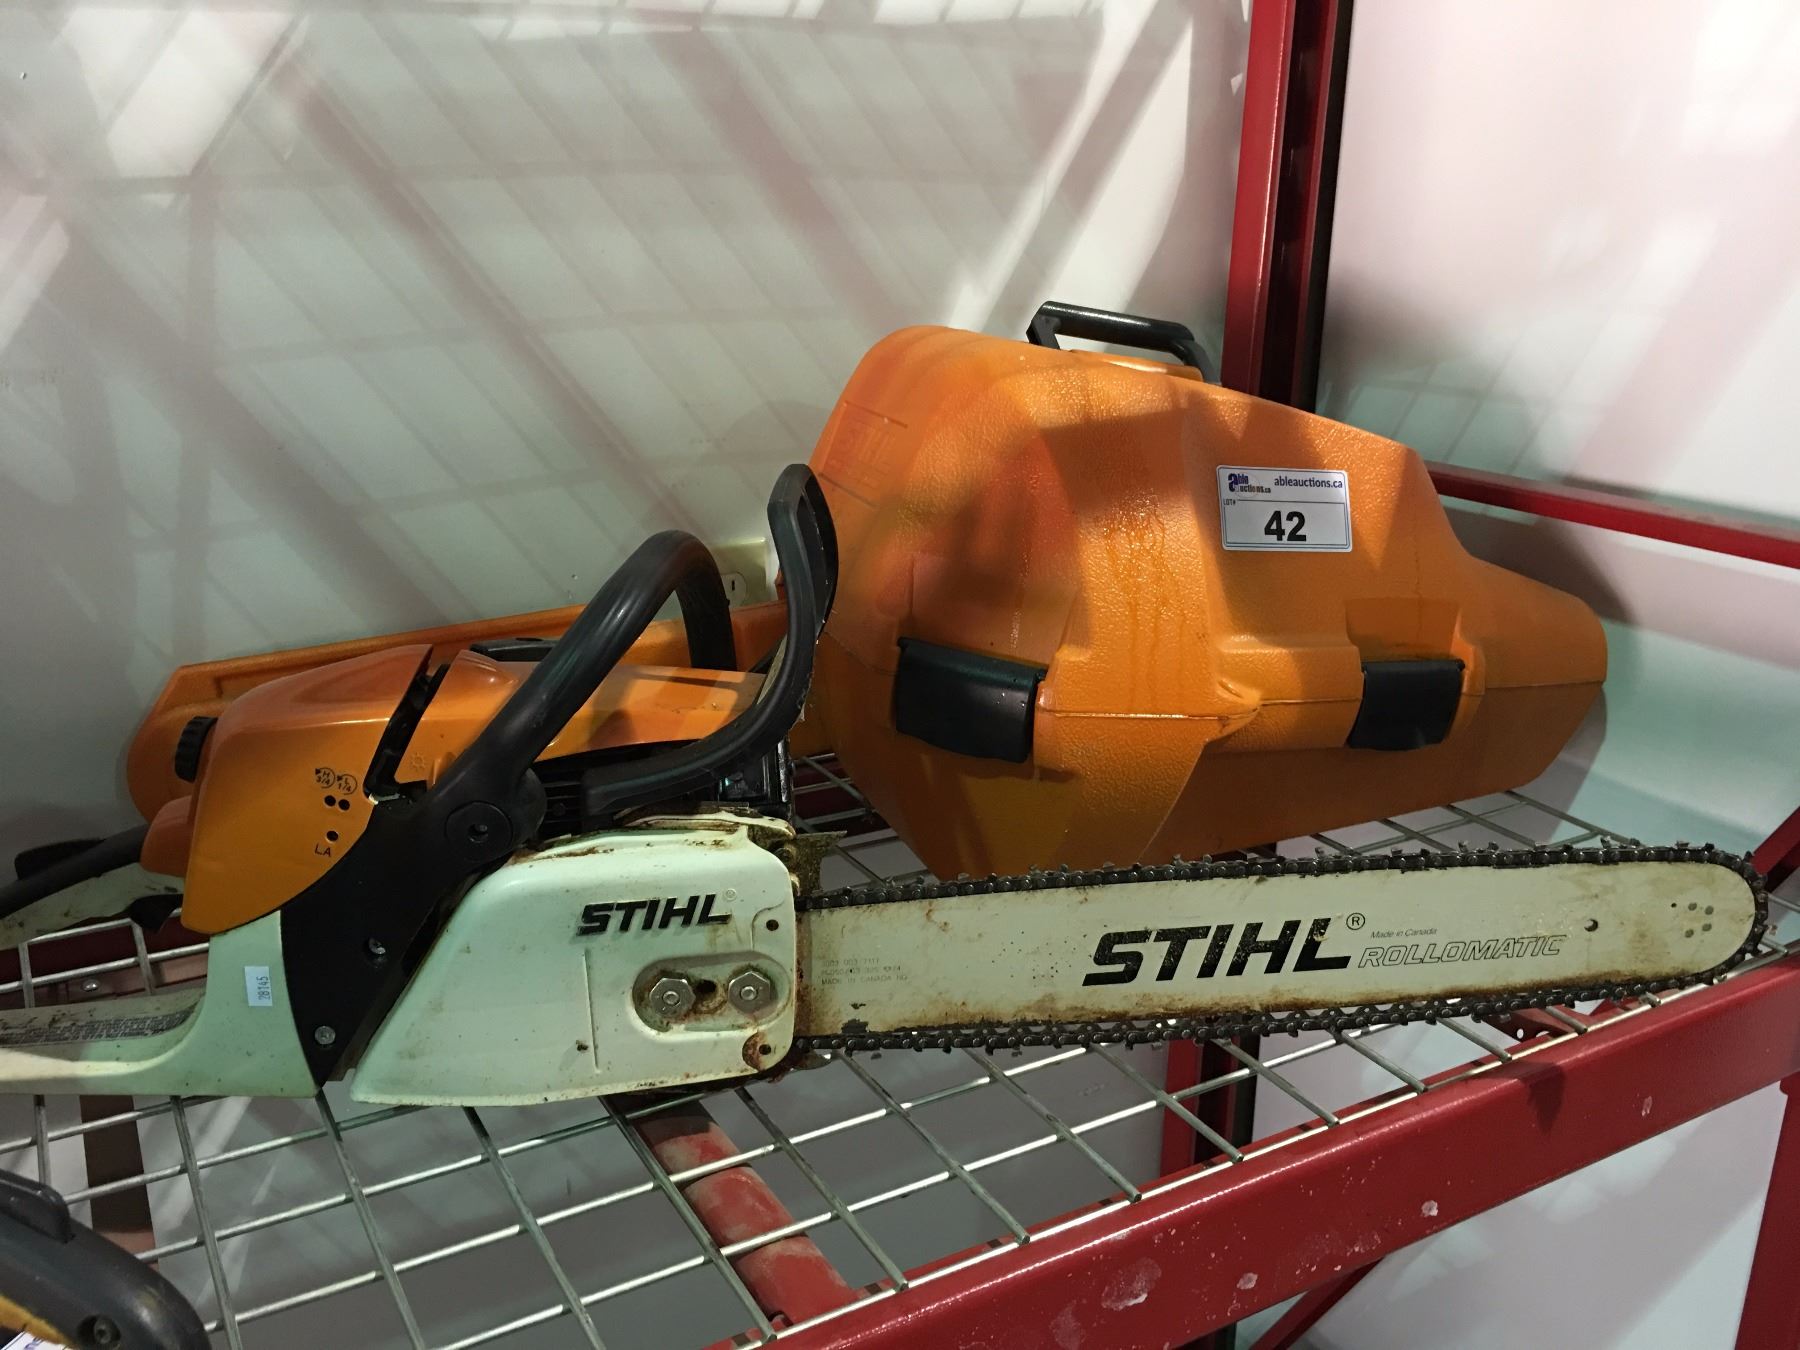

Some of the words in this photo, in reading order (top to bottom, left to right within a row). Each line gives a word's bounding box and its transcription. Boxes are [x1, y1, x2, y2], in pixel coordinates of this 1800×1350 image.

[1274, 476, 1343, 489] ableauctions.ca
[1264, 511, 1307, 542] 42
[315, 843, 331, 857] LA
[576, 894, 732, 936] STIHL
[1370, 930, 1394, 939] Made
[1404, 927, 1437, 938] Canada
[1081, 917, 1352, 987] STIHL
[1358, 935, 1567, 969] ROLLOMATIC
